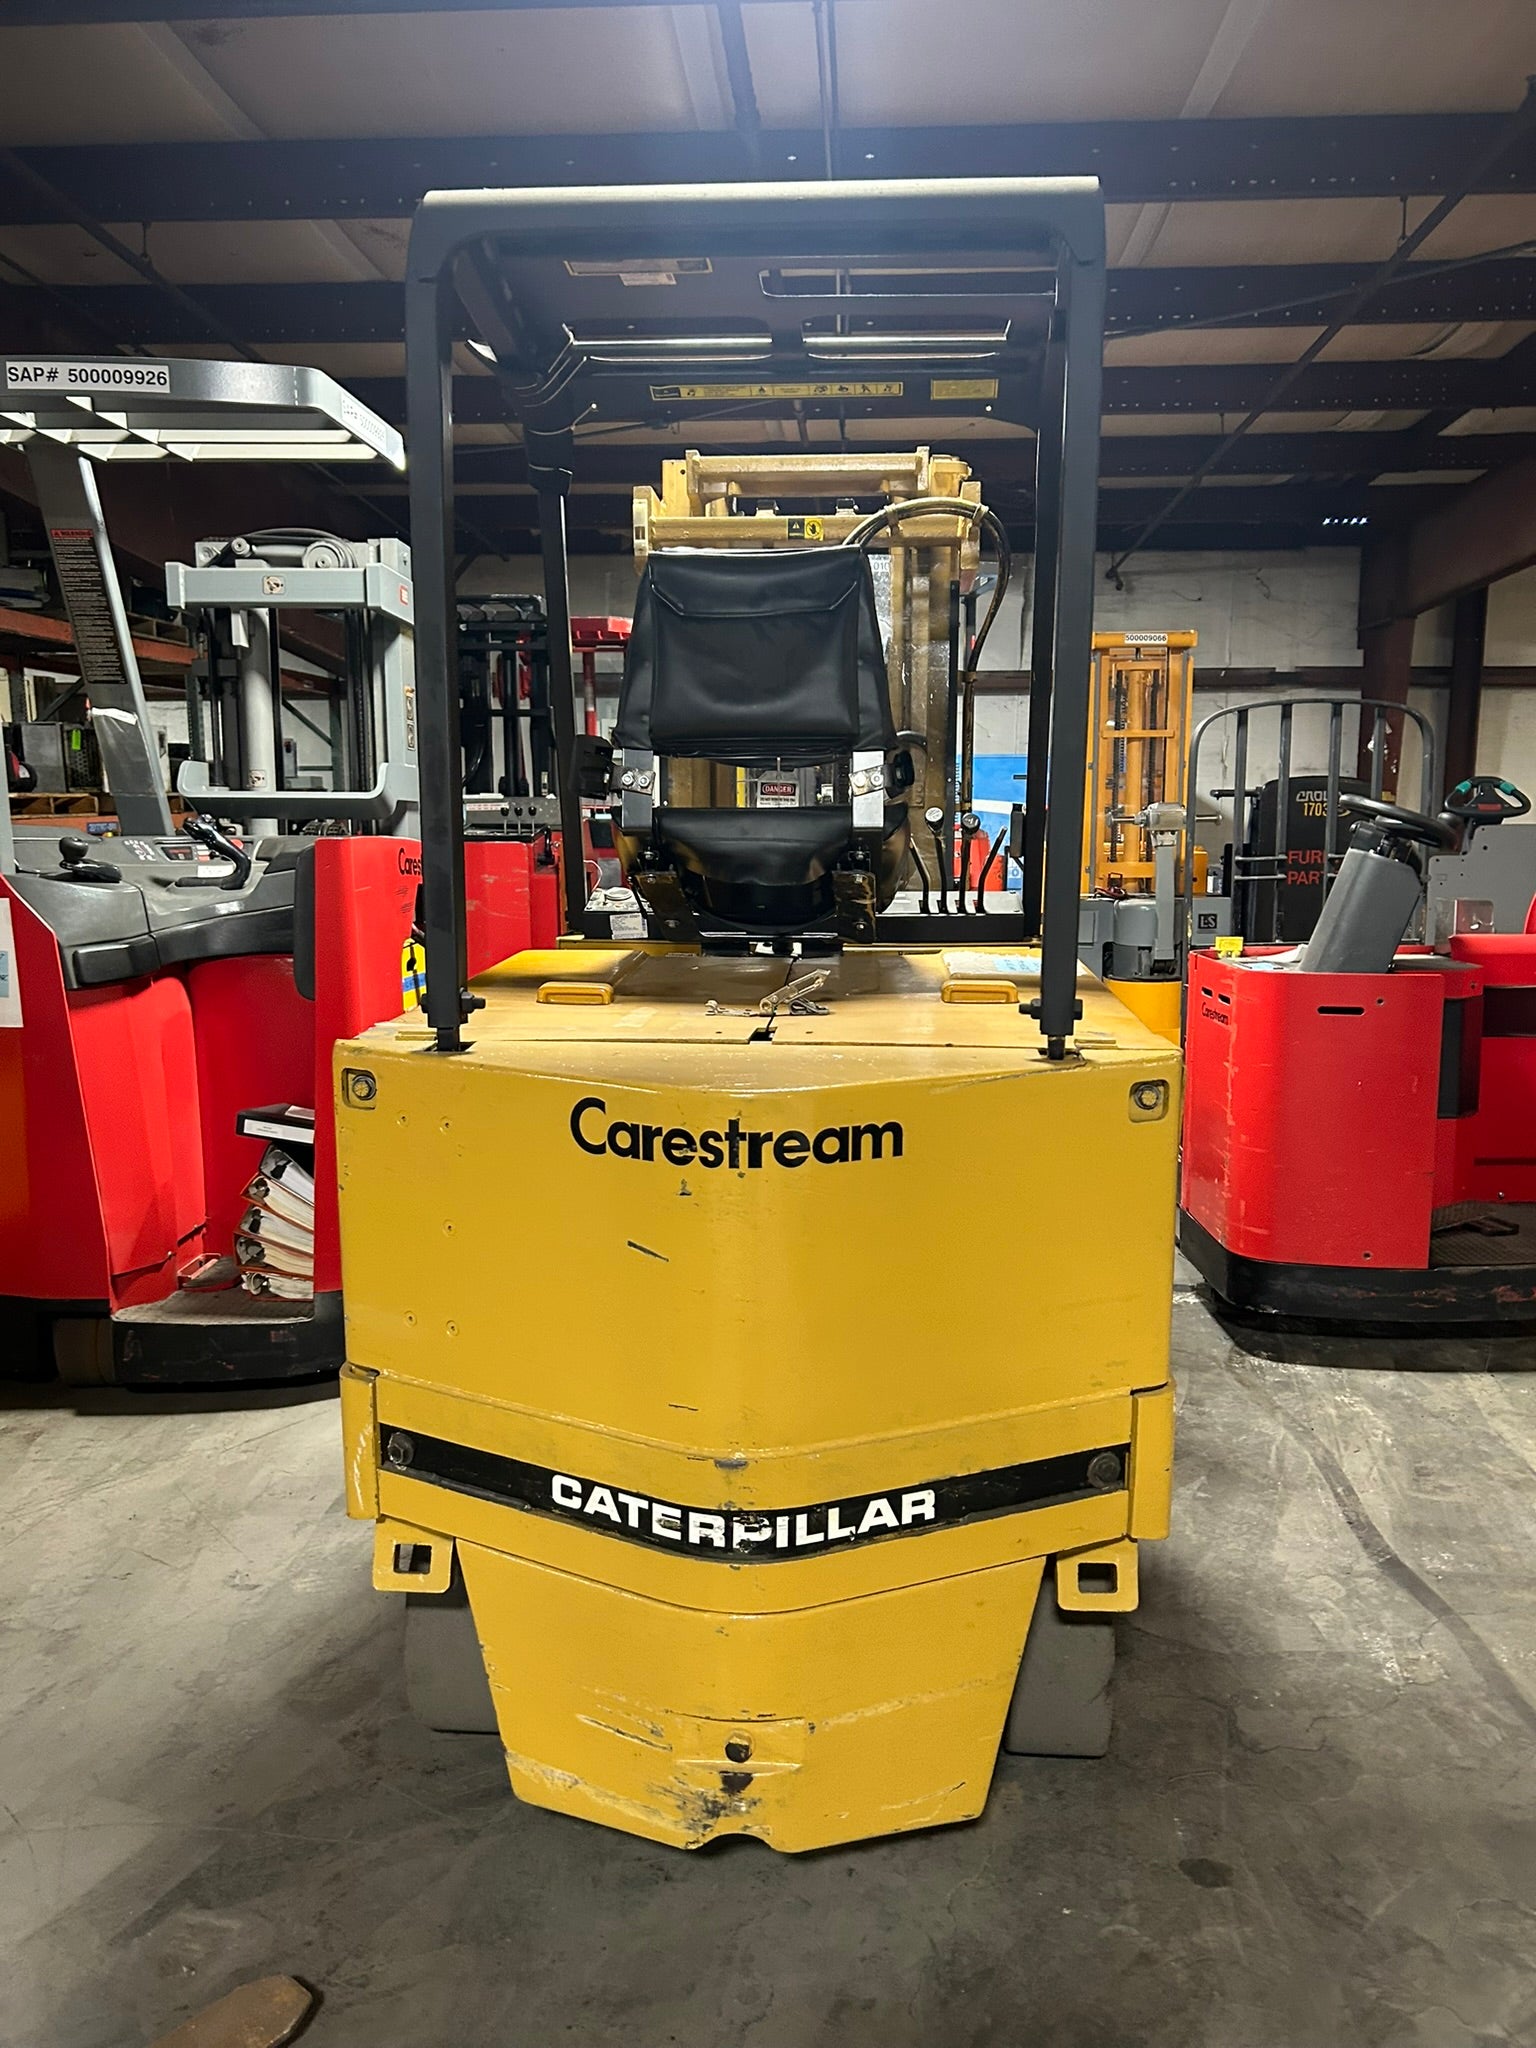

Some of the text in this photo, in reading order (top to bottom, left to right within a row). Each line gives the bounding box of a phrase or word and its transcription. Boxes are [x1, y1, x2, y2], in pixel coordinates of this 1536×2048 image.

[8, 366, 168, 386] SAP# 500009926
[765, 785, 792, 793] DANGER
[398, 847, 422, 875] Cares
[570, 1096, 904, 1169] Carestream
[551, 1474, 937, 1550] CATERPILLAR
